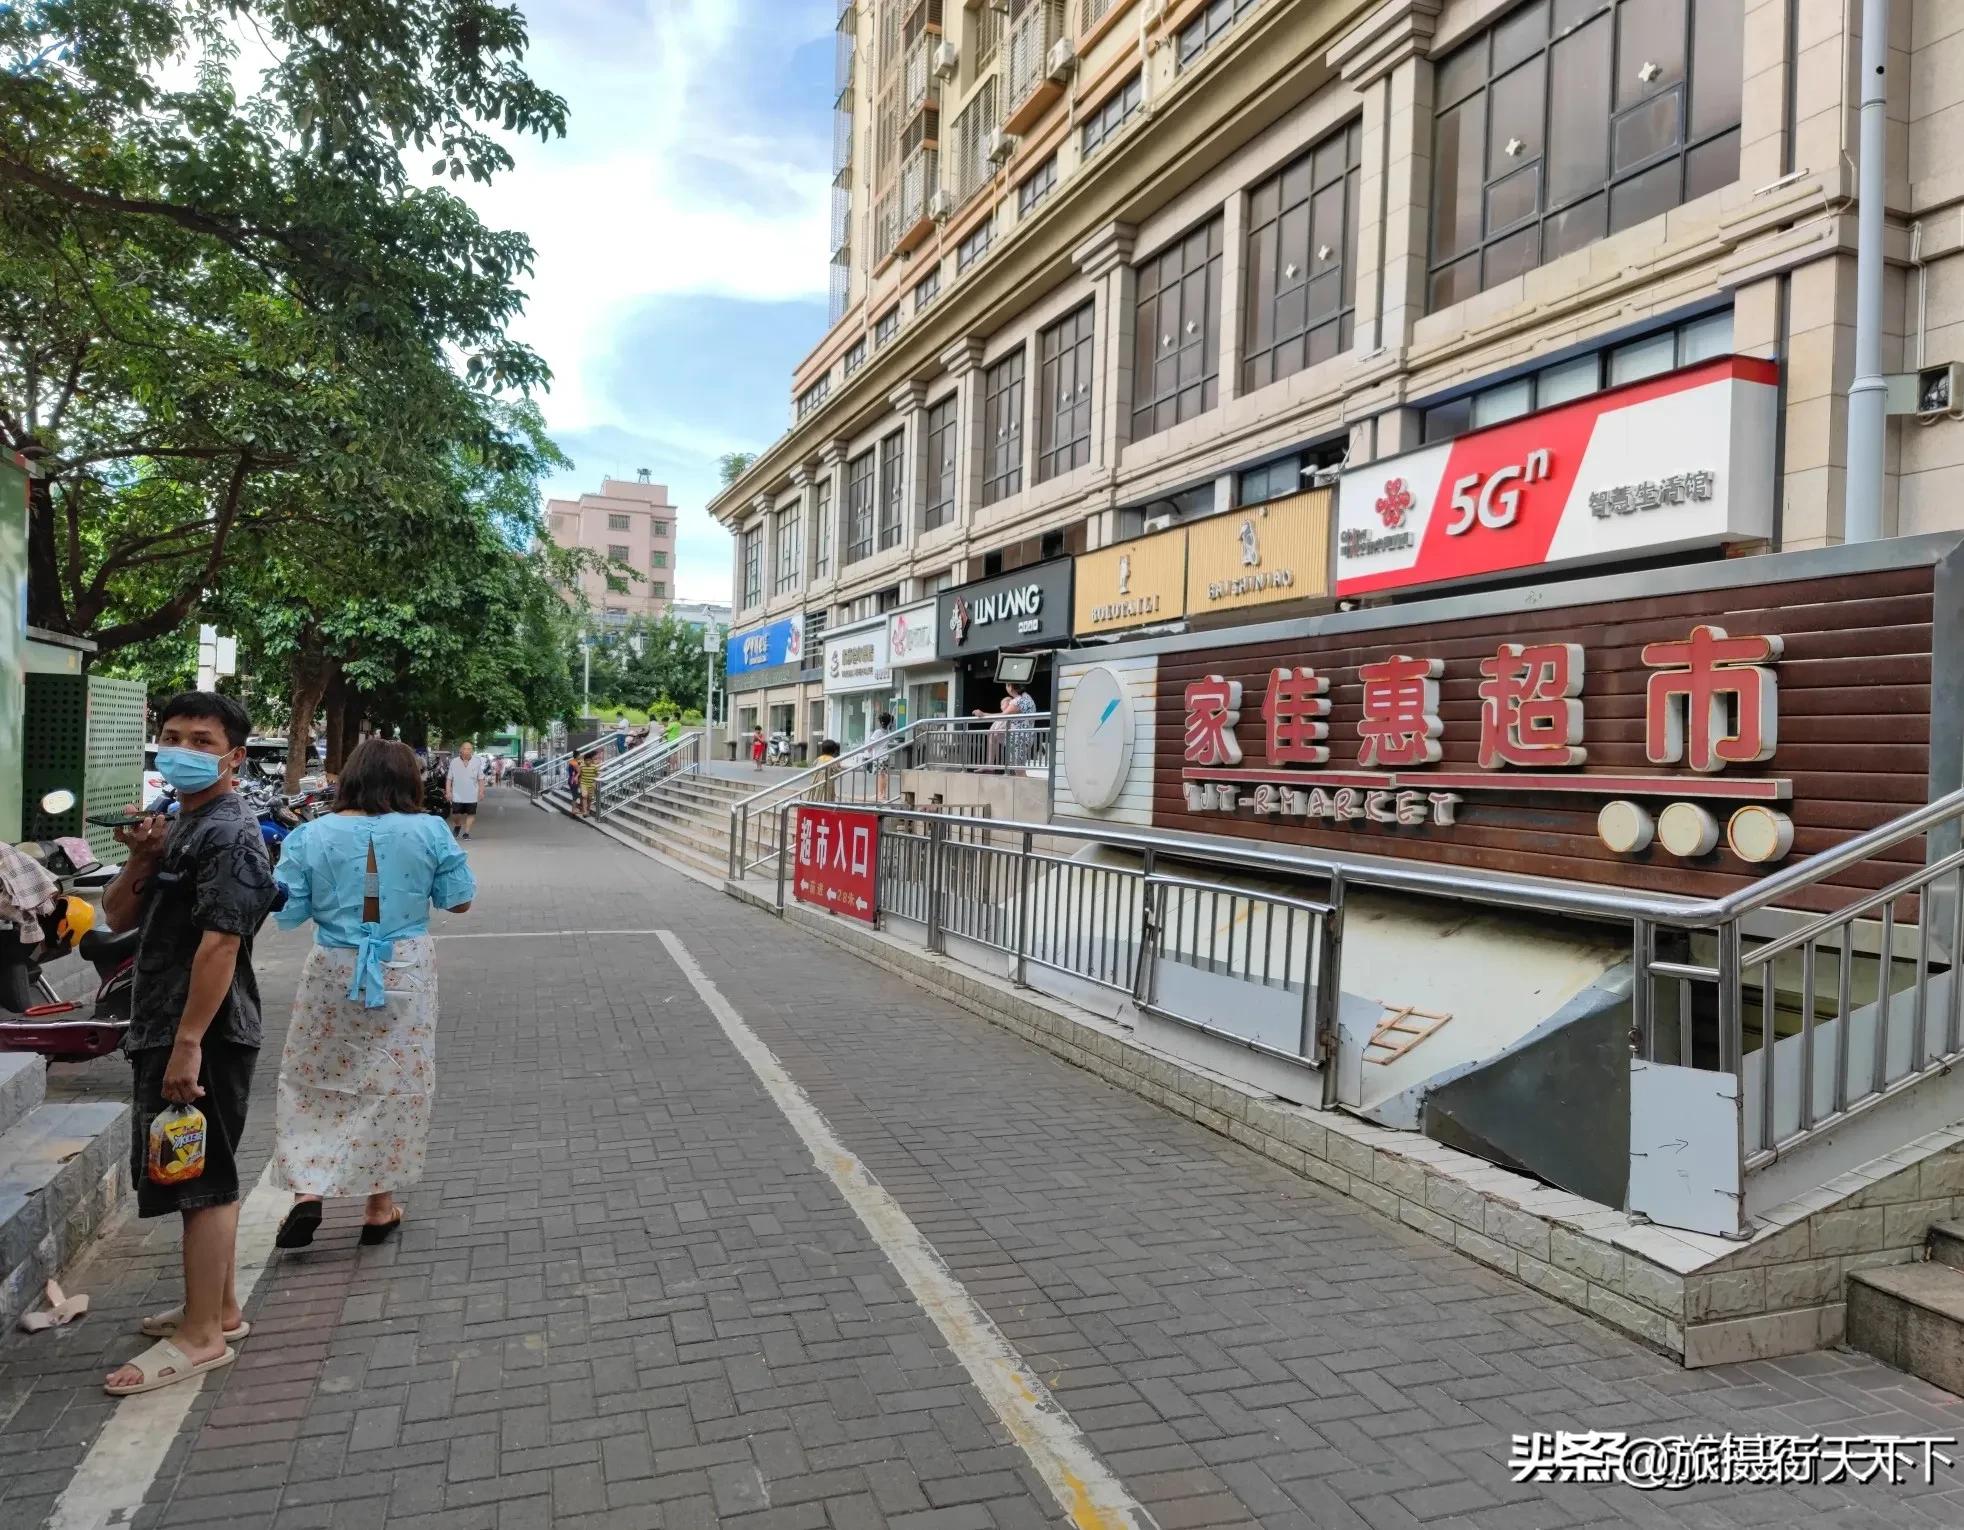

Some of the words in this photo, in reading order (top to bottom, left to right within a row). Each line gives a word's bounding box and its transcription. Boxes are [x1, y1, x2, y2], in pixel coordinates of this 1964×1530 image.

[1589, 470, 1714, 518] 智慧生活馆
[998, 584, 1041, 619] LANG
[1184, 625, 1784, 772] 家佳惠超市
[800, 817, 868, 877] 超市入口
